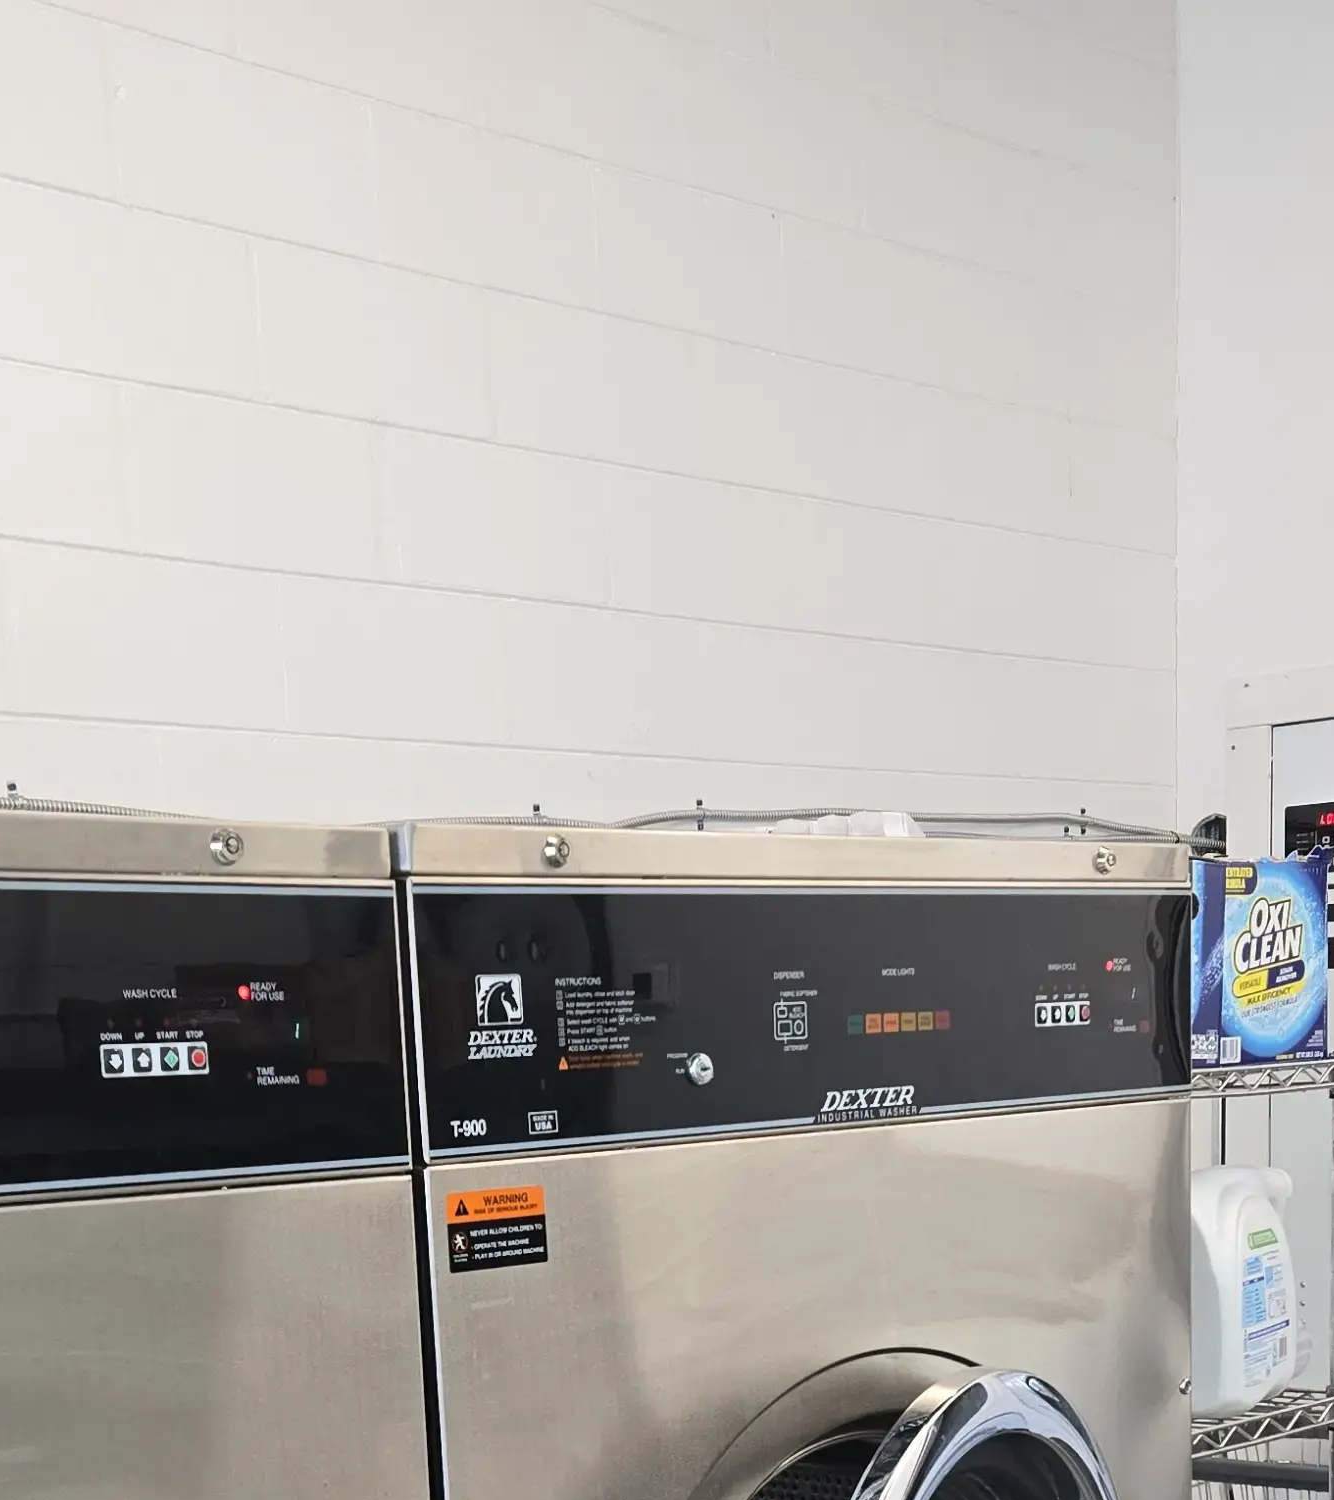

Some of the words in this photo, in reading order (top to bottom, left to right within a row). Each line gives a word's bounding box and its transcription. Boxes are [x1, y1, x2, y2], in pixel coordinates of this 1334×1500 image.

[1250, 897, 1290, 938] OXI
[1234, 926, 1303, 973] CLEAN
[122, 989, 149, 999] WASH
[149, 988, 177, 999] CYCLE
[250, 982, 277, 992] READY
[250, 991, 267, 1001] FOR
[269, 991, 284, 1001] USE
[1247, 995, 1261, 1005] MAX
[1261, 987, 1291, 1002] EFFICIENCY
[100, 1032, 123, 1042] DOWN
[135, 1032, 145, 1041] UP
[156, 1031, 179, 1041] START
[185, 1030, 204, 1040] STOP
[468, 1028, 534, 1046] DEXTER
[467, 1043, 538, 1060] LAUNDRY
[257, 1067, 275, 1076] TIME
[257, 1075, 300, 1086] REMAINING
[820, 1084, 915, 1112] DEXTER
[817, 1109, 875, 1124] INDUSTRIAL
[879, 1105, 917, 1117] WASHER
[450, 1119, 487, 1137] T-900
[535, 1122, 552, 1131] USA
[483, 1192, 528, 1206] WARNING
